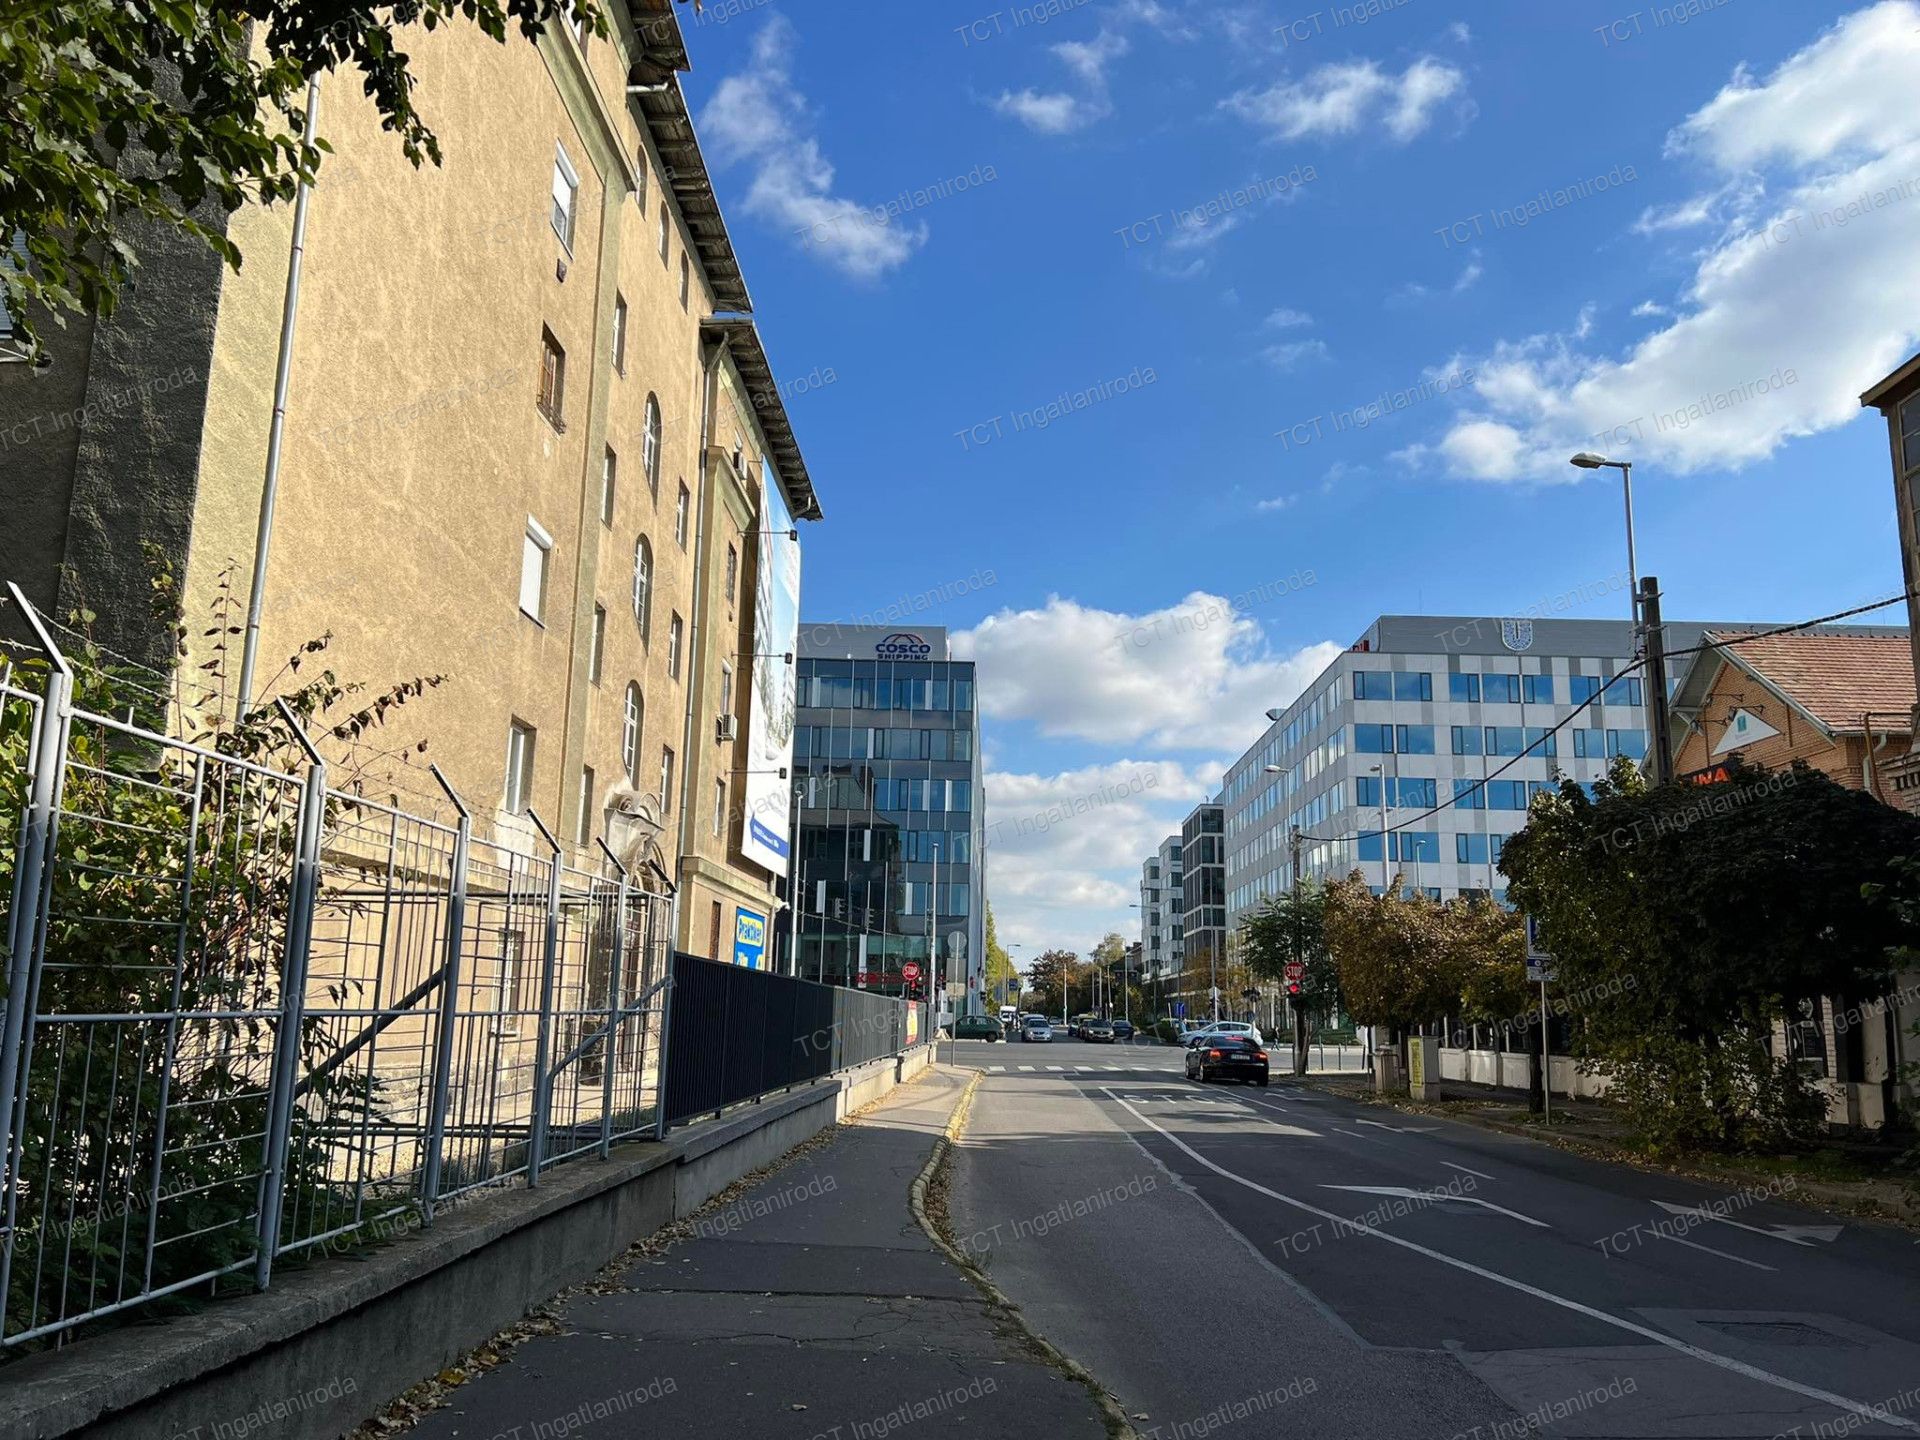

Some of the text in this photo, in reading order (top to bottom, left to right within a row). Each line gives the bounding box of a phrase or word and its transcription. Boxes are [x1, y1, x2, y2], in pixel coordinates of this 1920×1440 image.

[875, 643, 931, 654] COSCO
[877, 653, 929, 661] SHIPPING
[904, 966, 918, 976] STOP
[1286, 966, 1303, 977] STOP
